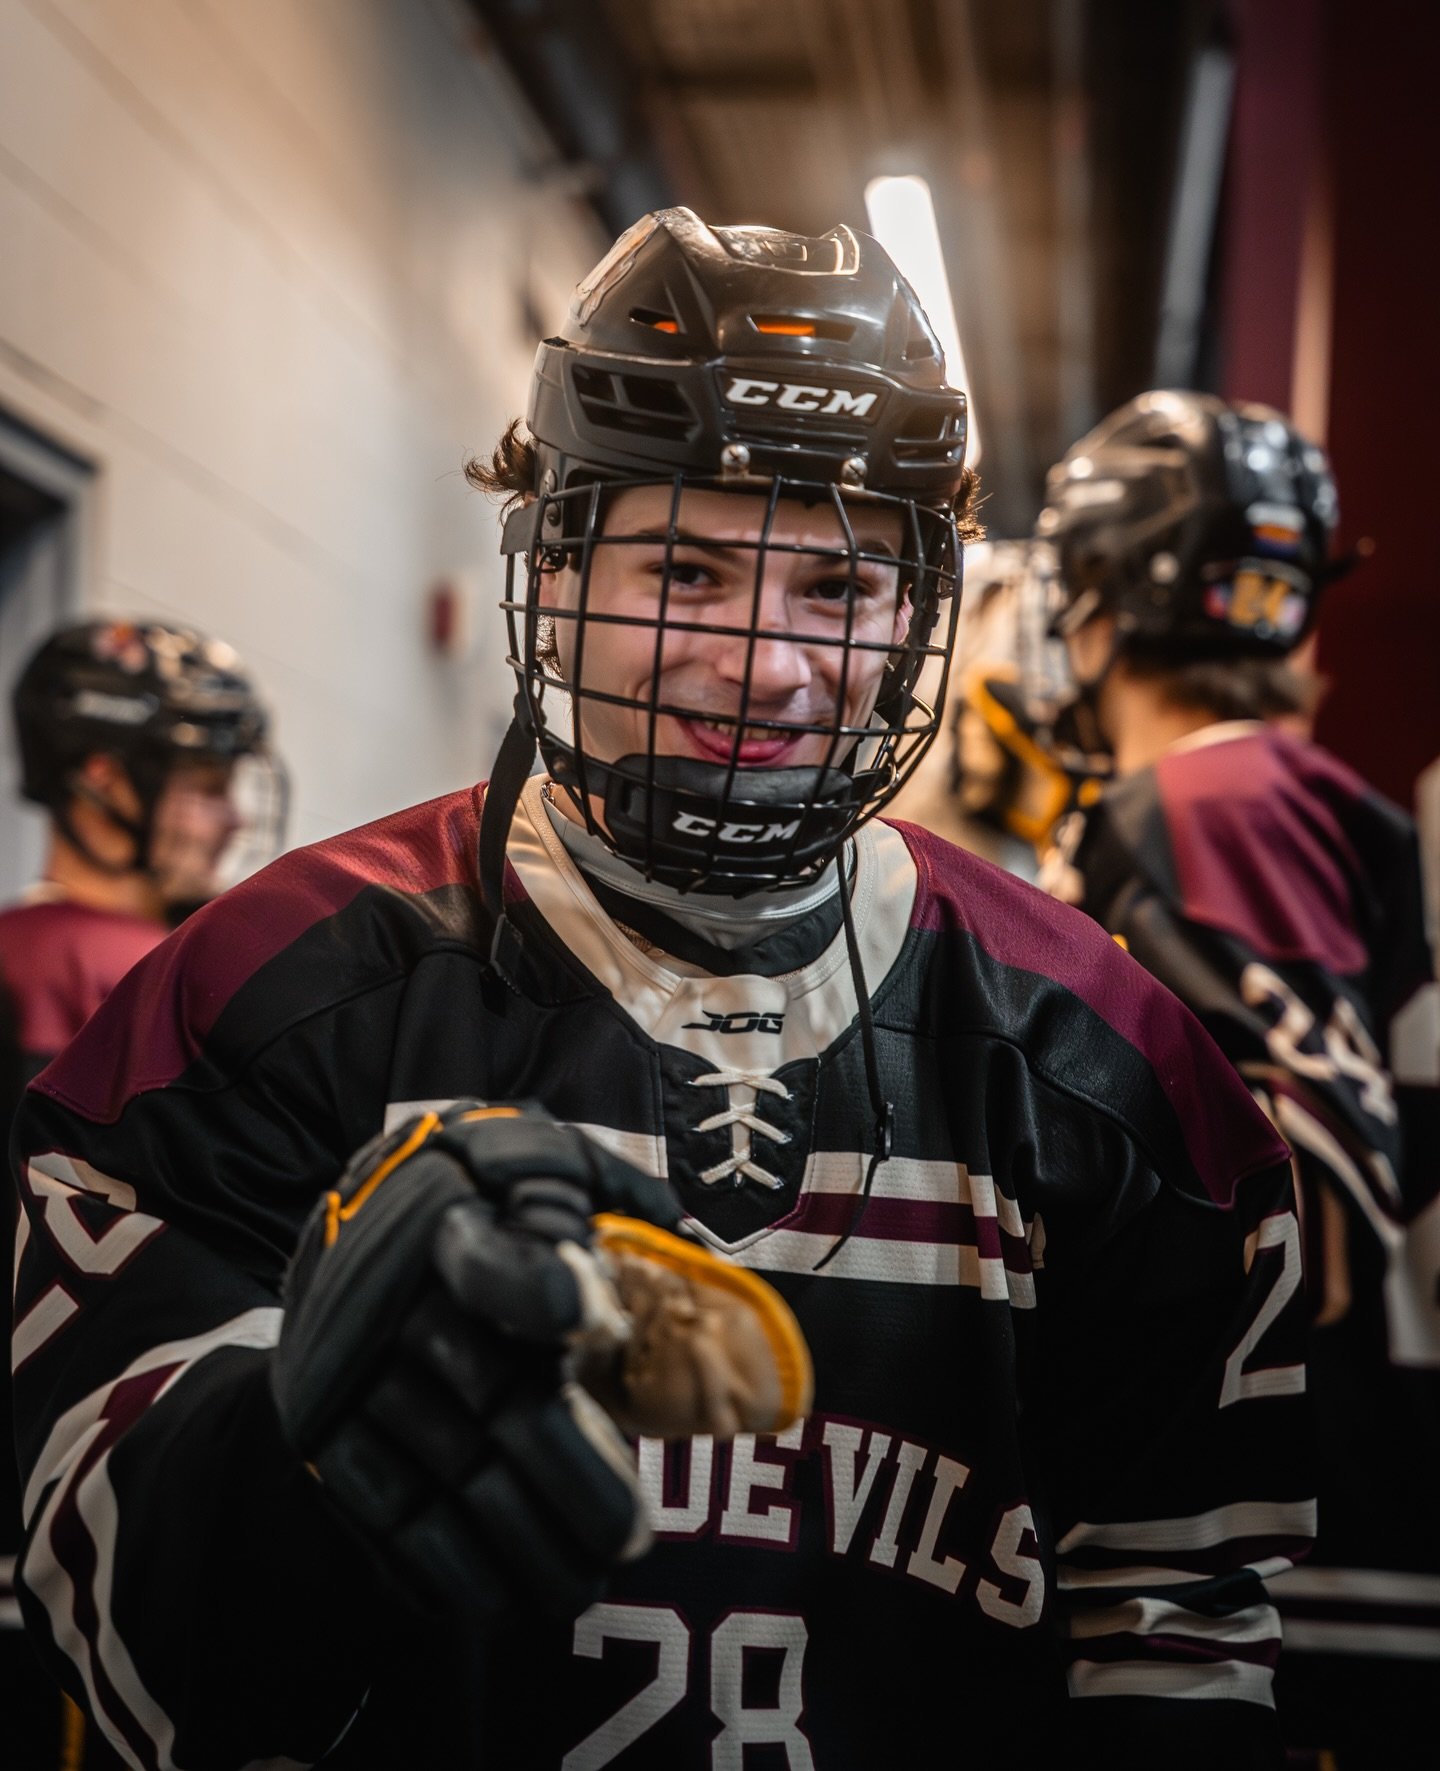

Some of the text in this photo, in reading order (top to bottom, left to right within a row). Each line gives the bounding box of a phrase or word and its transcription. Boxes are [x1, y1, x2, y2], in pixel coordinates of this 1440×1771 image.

[726, 378, 878, 416] CCM
[672, 811, 801, 843] CCM
[681, 1010, 786, 1035] JOG
[638, 1417, 1046, 1629] DEVILS
[560, 1602, 816, 1771] 28
